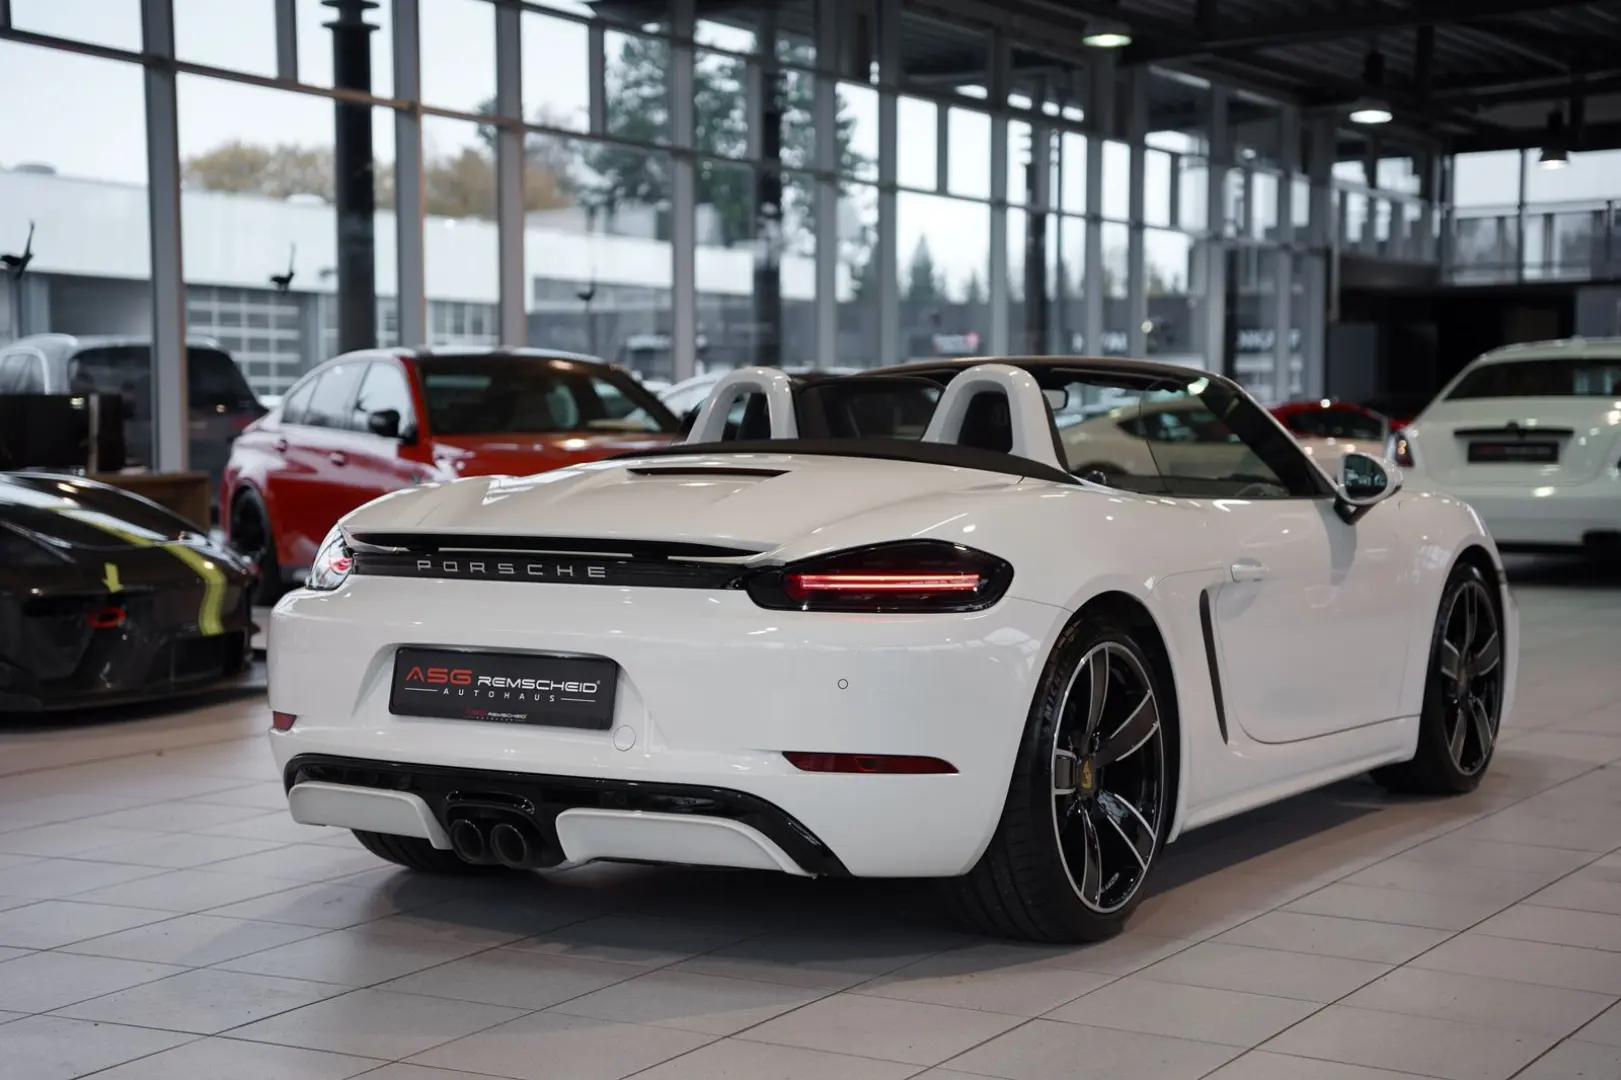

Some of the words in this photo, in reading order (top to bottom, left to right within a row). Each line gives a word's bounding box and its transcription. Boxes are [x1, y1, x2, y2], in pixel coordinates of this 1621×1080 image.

[417, 559, 606, 578] PORSCHE
[406, 666, 473, 685] ASG
[443, 688, 555, 702] AUTOHAUS
